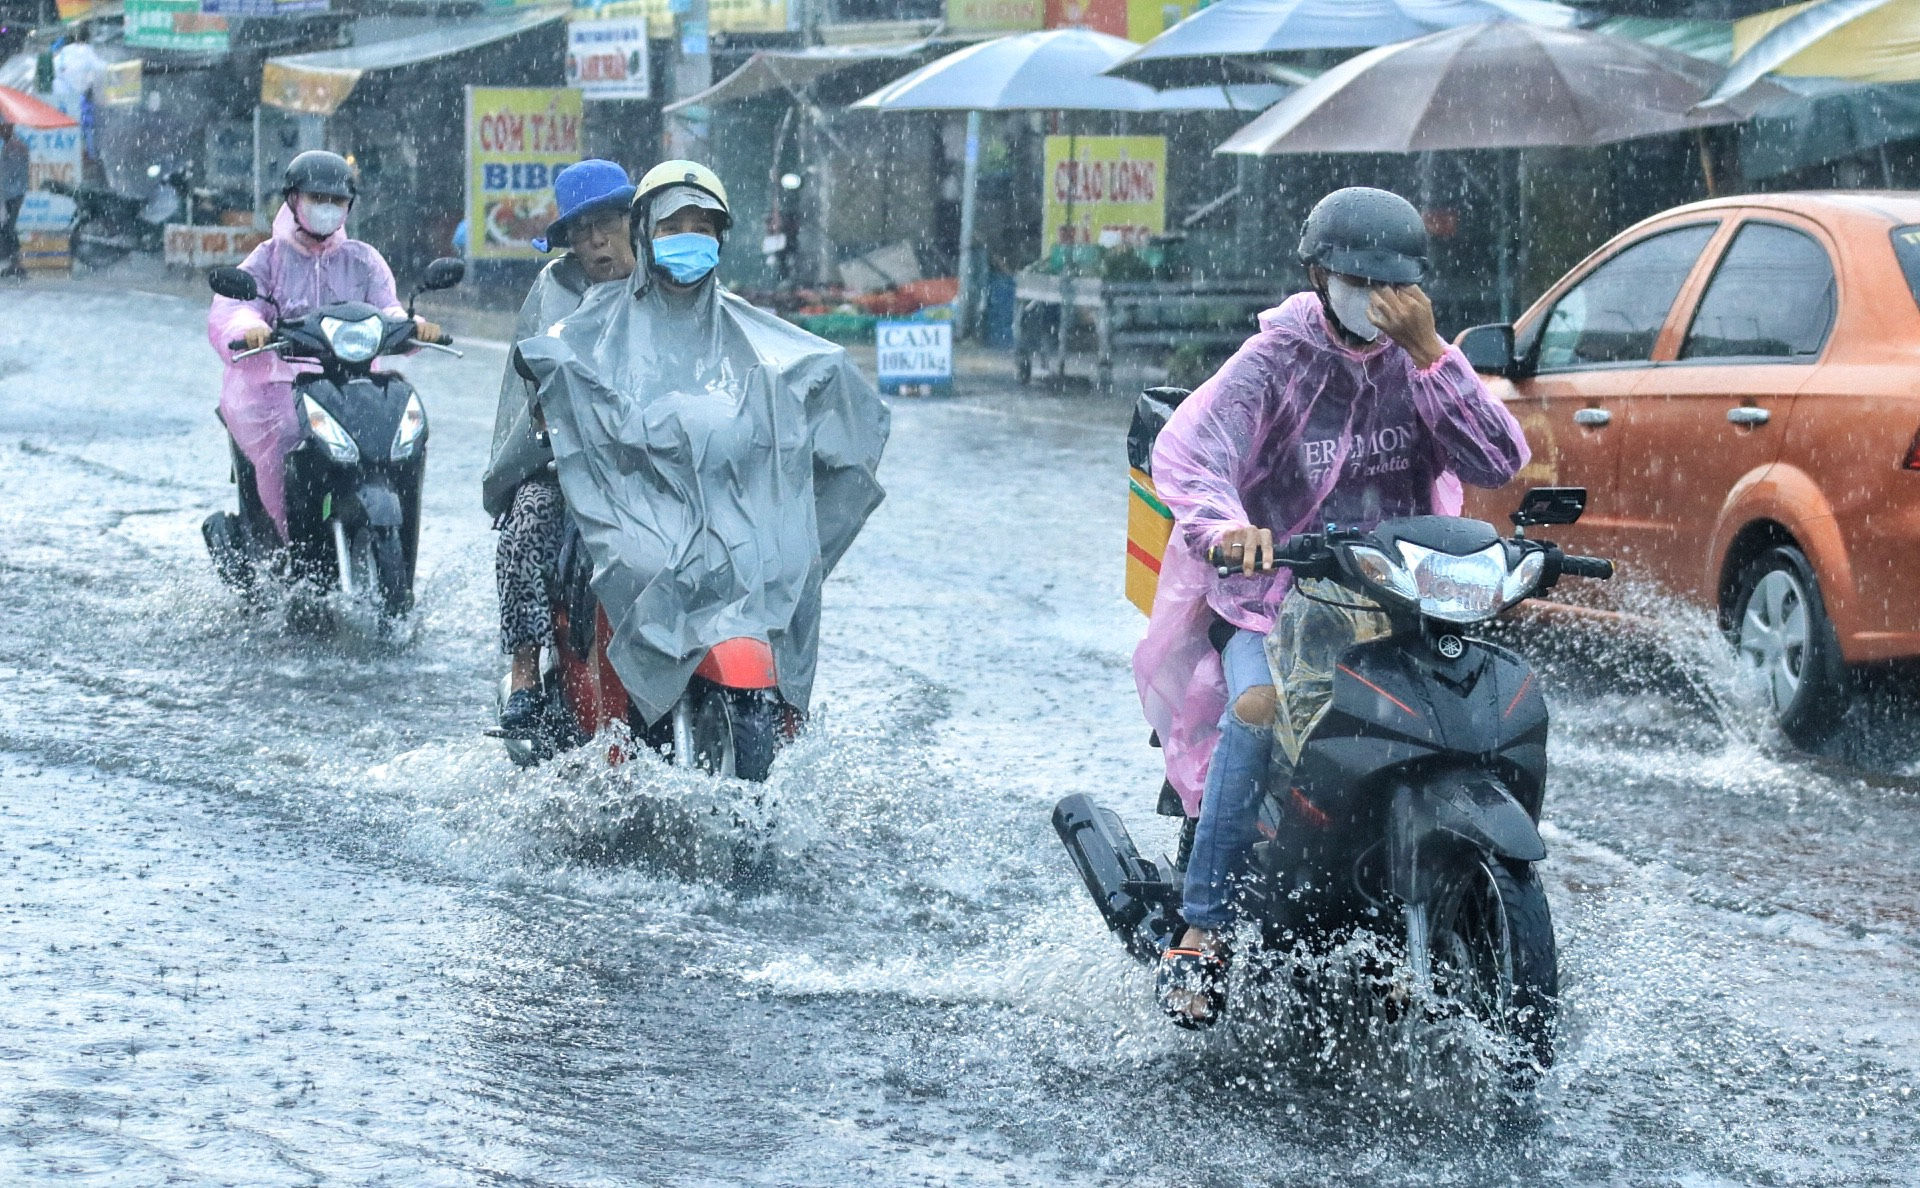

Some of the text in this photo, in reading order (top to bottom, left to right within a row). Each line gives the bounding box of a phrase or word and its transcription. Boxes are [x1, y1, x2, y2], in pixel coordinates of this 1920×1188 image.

[480, 95, 577, 152] CƠM TẤM
[884, 327, 940, 347] CAM
[882, 351, 947, 373] 10K/1kg
